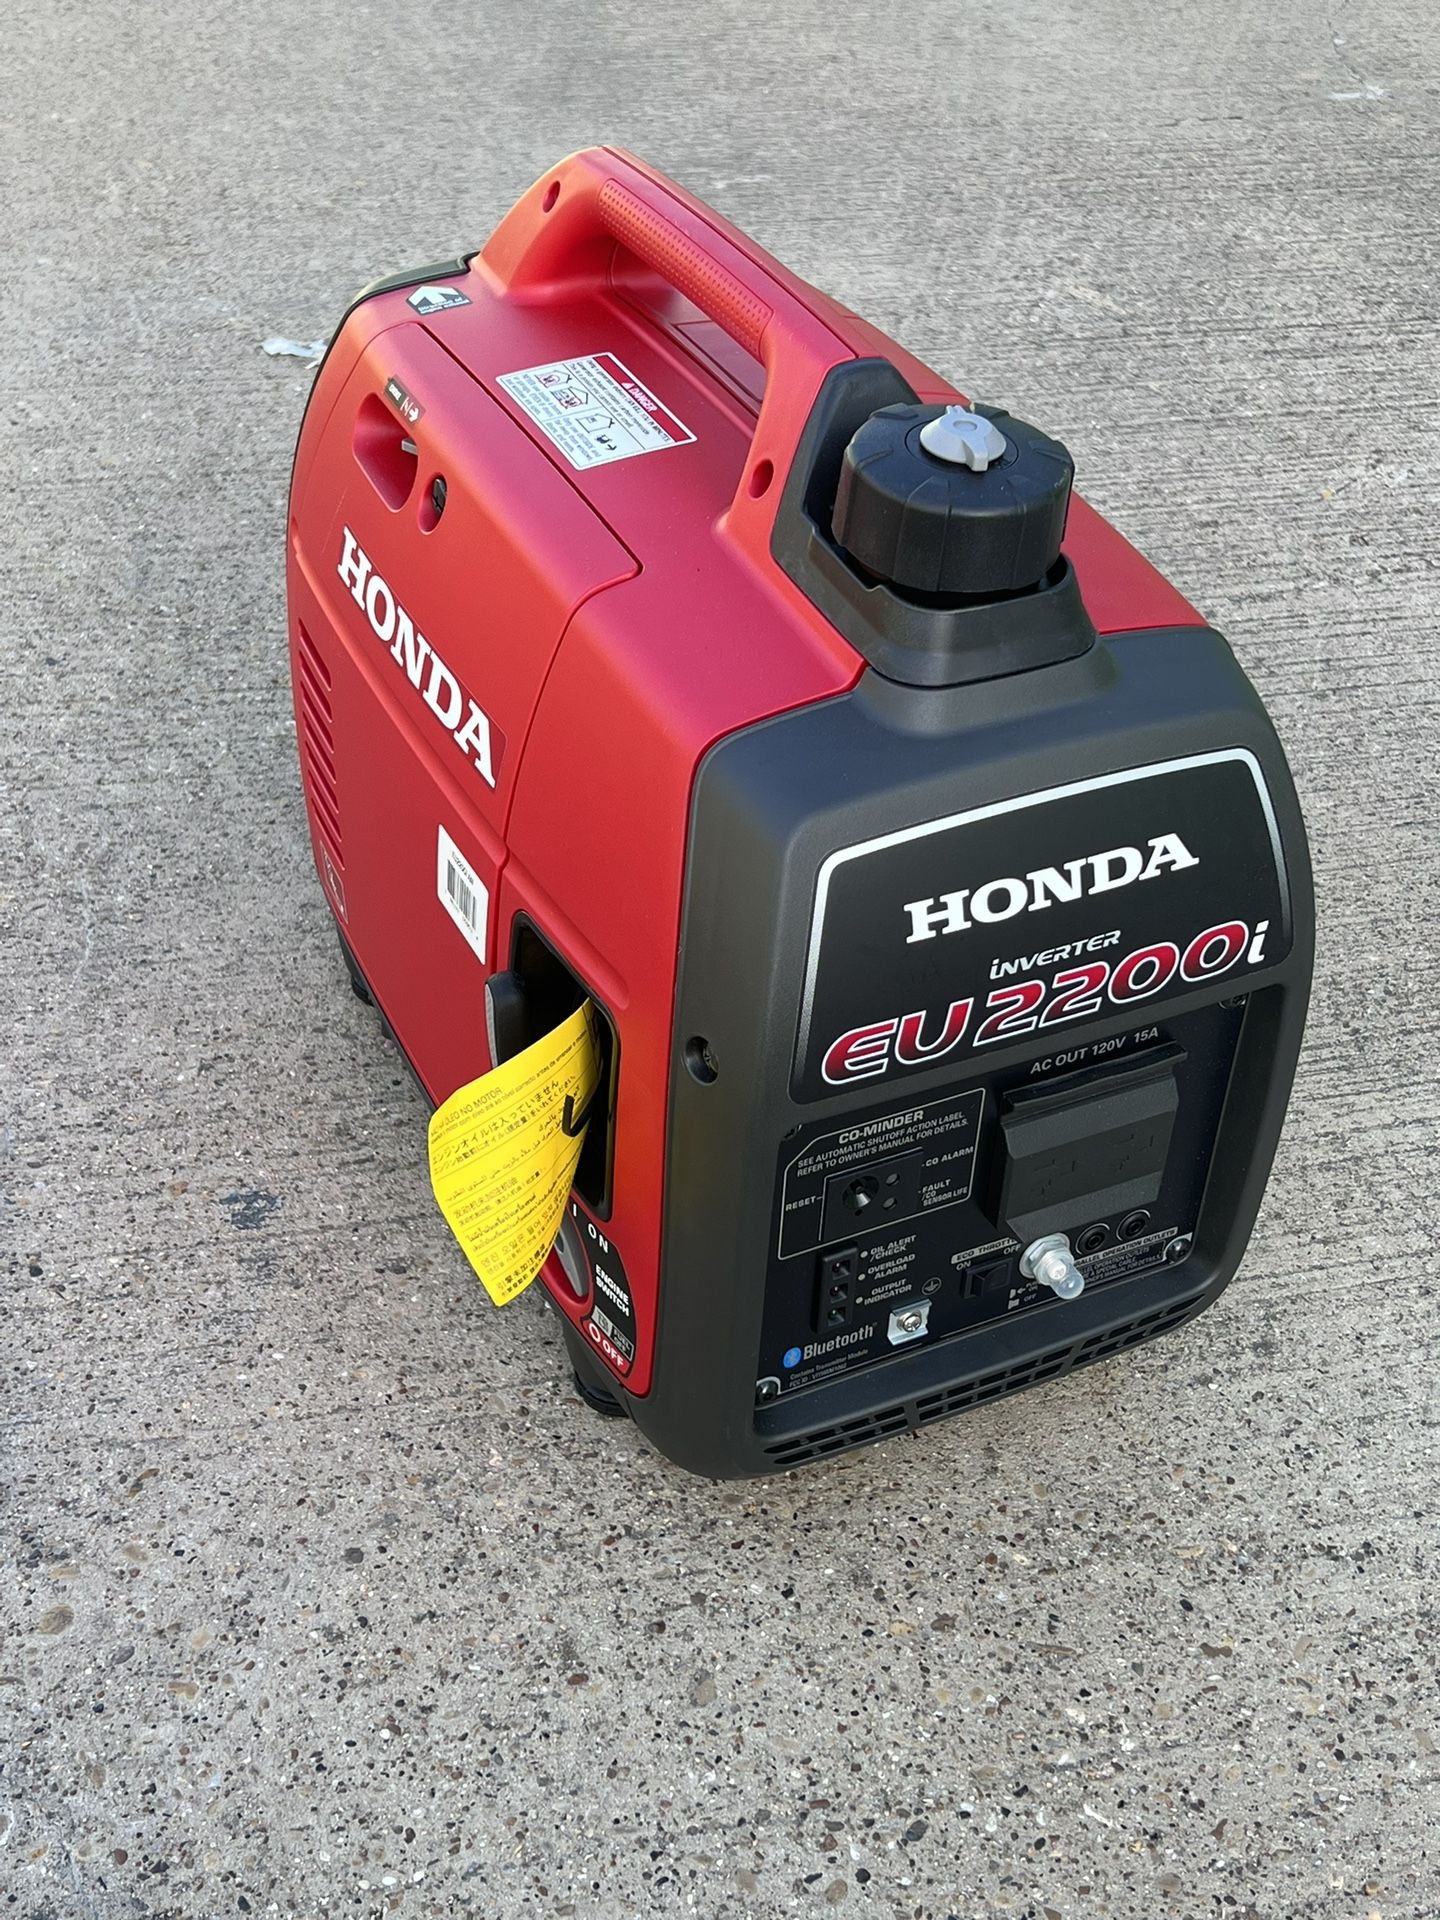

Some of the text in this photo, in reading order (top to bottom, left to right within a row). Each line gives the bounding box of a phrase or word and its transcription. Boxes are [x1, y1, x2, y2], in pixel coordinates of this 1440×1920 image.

[629, 388, 657, 412] DANGER
[337, 526, 496, 789] HONDA
[904, 833, 1199, 943] HONDA
[821, 920, 1270, 1085] EU2200i
[1030, 1026, 1159, 1075] AC OUT 120V 15A
[459, 1104, 474, 1116] NO
[473, 1087, 503, 1108] MOTOR
[837, 1111, 923, 1143] CO-MINDER
[797, 1163, 823, 1177] REFER
[825, 1159, 836, 1168] TO
[838, 1146, 877, 1164] OWNER'S
[878, 1135, 914, 1151] MANUAL
[916, 1129, 933, 1140] FOR
[798, 1156, 814, 1168] SEE
[816, 1141, 866, 1161] AUTOMATIC
[867, 1129, 905, 1146] SHUTOFF
[906, 1120, 937, 1134] ACTION
[926, 1146, 975, 1167] CO ALARM
[922, 1179, 951, 1193] FAULT
[922, 1186, 969, 1206] SENSOR LIFE
[785, 1197, 817, 1212] RESET
[588, 1223, 609, 1254] ON
[870, 1235, 916, 1255] OIL ALERT
[1102, 1241, 1142, 1257] OPERATION
[1142, 1229, 1176, 1243] OUTLETS
[868, 1254, 915, 1274] OVERLOAD
[870, 1245, 906, 1262] /CHECK
[955, 1251, 975, 1260] ECO
[956, 1243, 1022, 1271] ON OFF
[596, 1265, 629, 1306] ENGINE
[874, 1264, 907, 1279] ALARM
[596, 1276, 629, 1316] SWITCH
[864, 1284, 912, 1305] INDICATOR
[871, 1279, 908, 1295] OUTPUT
[603, 1340, 623, 1366] OFF
[804, 1326, 873, 1359] Bluetooth
